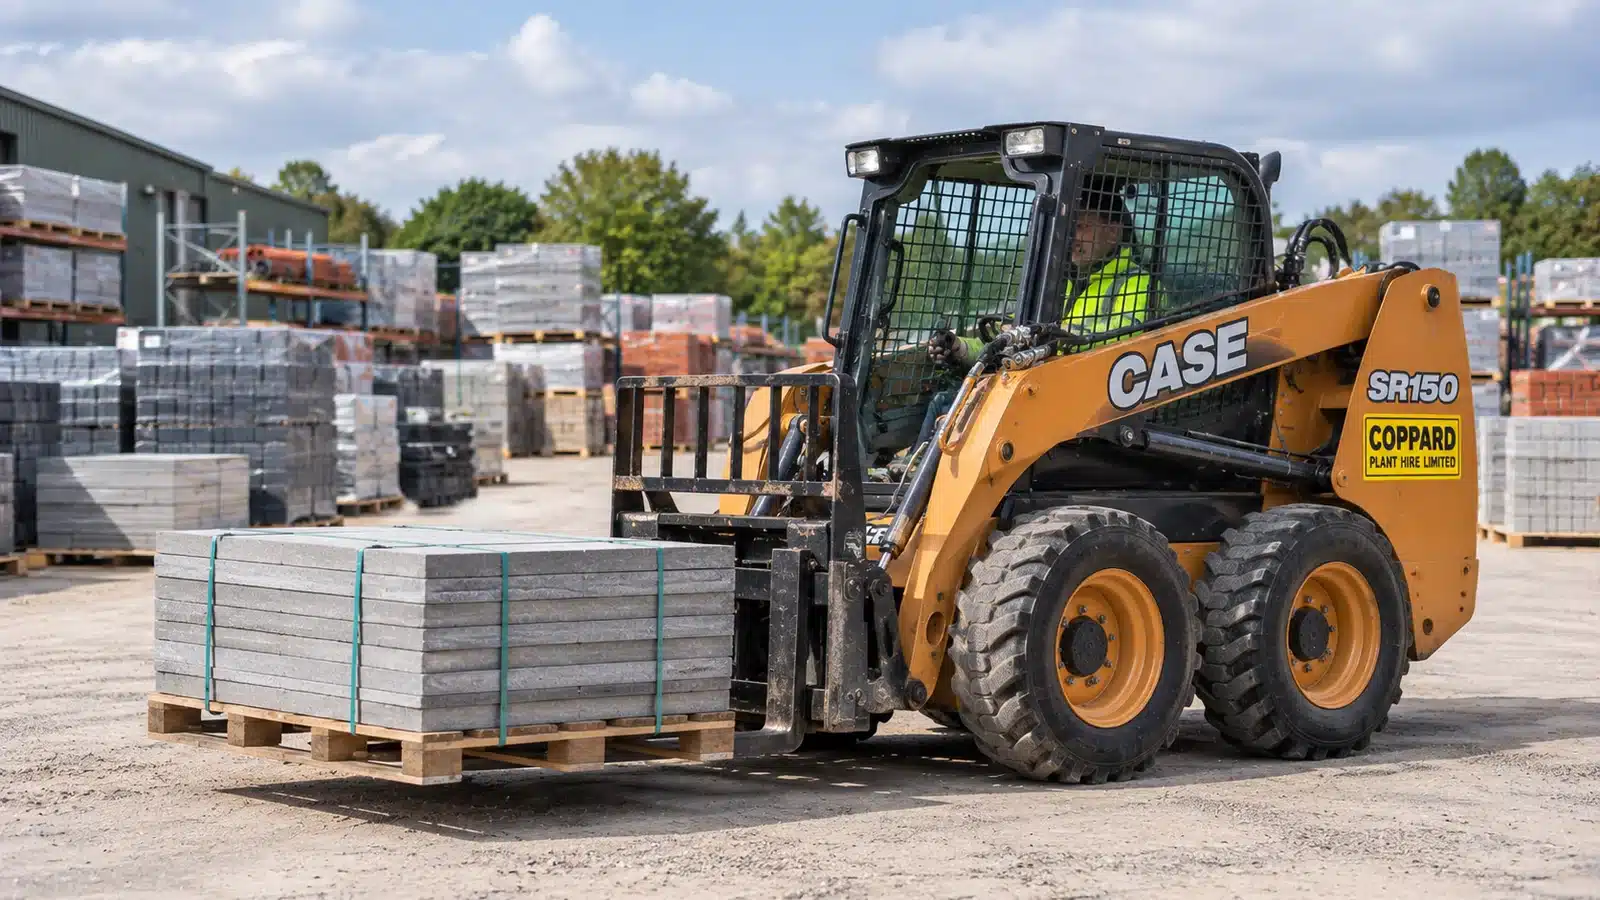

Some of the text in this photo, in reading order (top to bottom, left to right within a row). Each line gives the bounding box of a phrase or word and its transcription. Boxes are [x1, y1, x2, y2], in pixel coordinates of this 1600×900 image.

[1107, 317, 1249, 411] CASE
[1367, 369, 1459, 404] SR150
[1369, 425, 1456, 450] COPPARD
[1369, 456, 1456, 468] PLANT HIRE LIMITED
